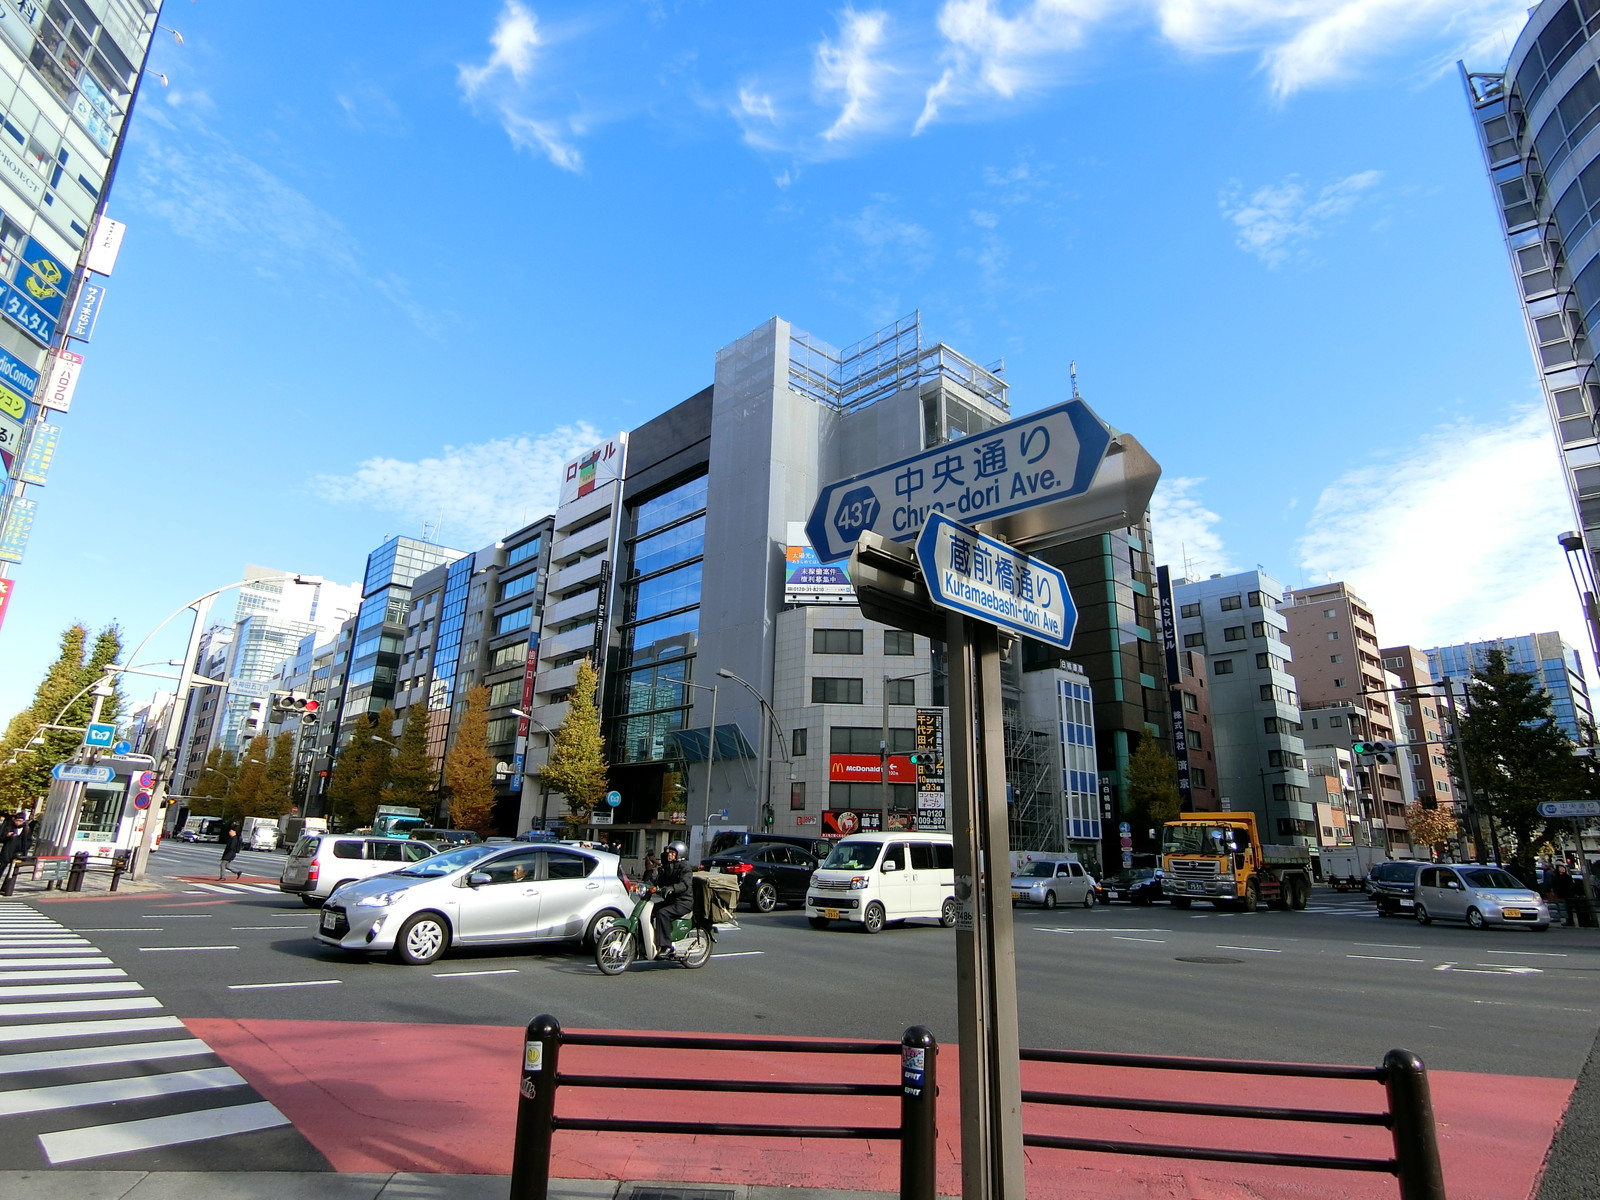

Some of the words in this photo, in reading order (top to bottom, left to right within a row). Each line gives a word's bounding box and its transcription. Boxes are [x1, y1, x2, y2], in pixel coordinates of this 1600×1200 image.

[7, 296, 49, 341] タムタム
[41, 422, 60, 434] 5F
[895, 425, 1050, 502] 中央通り
[1010, 468, 1062, 500] Ave.
[16, 498, 37, 509] 4F
[838, 497, 876, 530] 437
[949, 534, 1052, 609] 蔵前橋通り
[945, 571, 1040, 627] Kuramaebashi-dori
[1043, 611, 1061, 635] Ave.
[1161, 597, 1176, 650] KSKビル
[1171, 710, 1186, 751] 株式会社
[918, 817, 945, 825] 009-897
[926, 810, 943, 818] 0120
